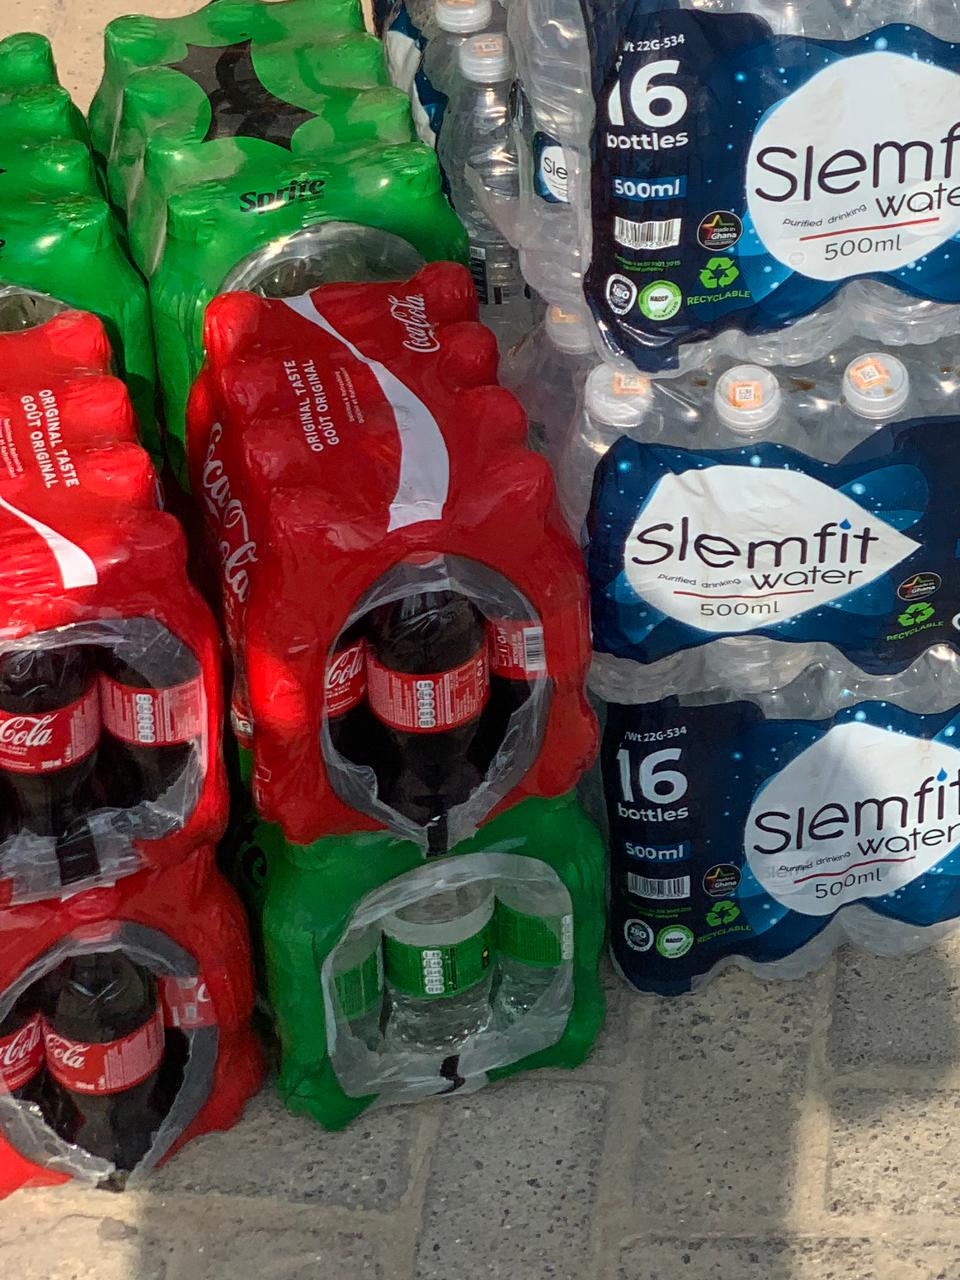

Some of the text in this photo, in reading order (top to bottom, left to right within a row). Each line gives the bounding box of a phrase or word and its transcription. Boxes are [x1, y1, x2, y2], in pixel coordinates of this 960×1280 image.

[636, 34, 685, 52] 22G-534
[608, 59, 688, 128] 16
[606, 132, 689, 151] bottles
[240, 179, 326, 215] Sprite
[614, 179, 680, 198] 500ml
[783, 203, 868, 228] purified drinking
[711, 232, 737, 241] Ghana
[824, 234, 902, 262] 500ml
[650, 294, 670, 303] HACCP
[687, 290, 751, 306] RECYCLABLE
[387, 294, 441, 353] Coca-Cola
[302, 359, 330, 414] ORIGINAL
[283, 360, 324, 453] ORIGINAL TASTE
[21, 395, 59, 489] GOÛT ORIGINAL
[38, 389, 81, 488] ORIGINAL TASTE
[631, 516, 879, 570] Slemfit
[658, 572, 742, 589] purified drinking
[751, 566, 863, 592] water
[699, 600, 781, 617] 500ml
[886, 621, 944, 641] RECYCLABLE
[327, 645, 363, 690] Cola
[0, 713, 59, 747] Cola
[624, 726, 688, 743] /Wt 22G-534
[617, 748, 688, 804] 16
[617, 803, 689, 822] bottles
[625, 842, 684, 861] 500ml
[816, 850, 851, 867] drinking
[714, 880, 737, 889] Ghana
[815, 868, 882, 900] 500ml
[0, 1020, 42, 1066] Cola
